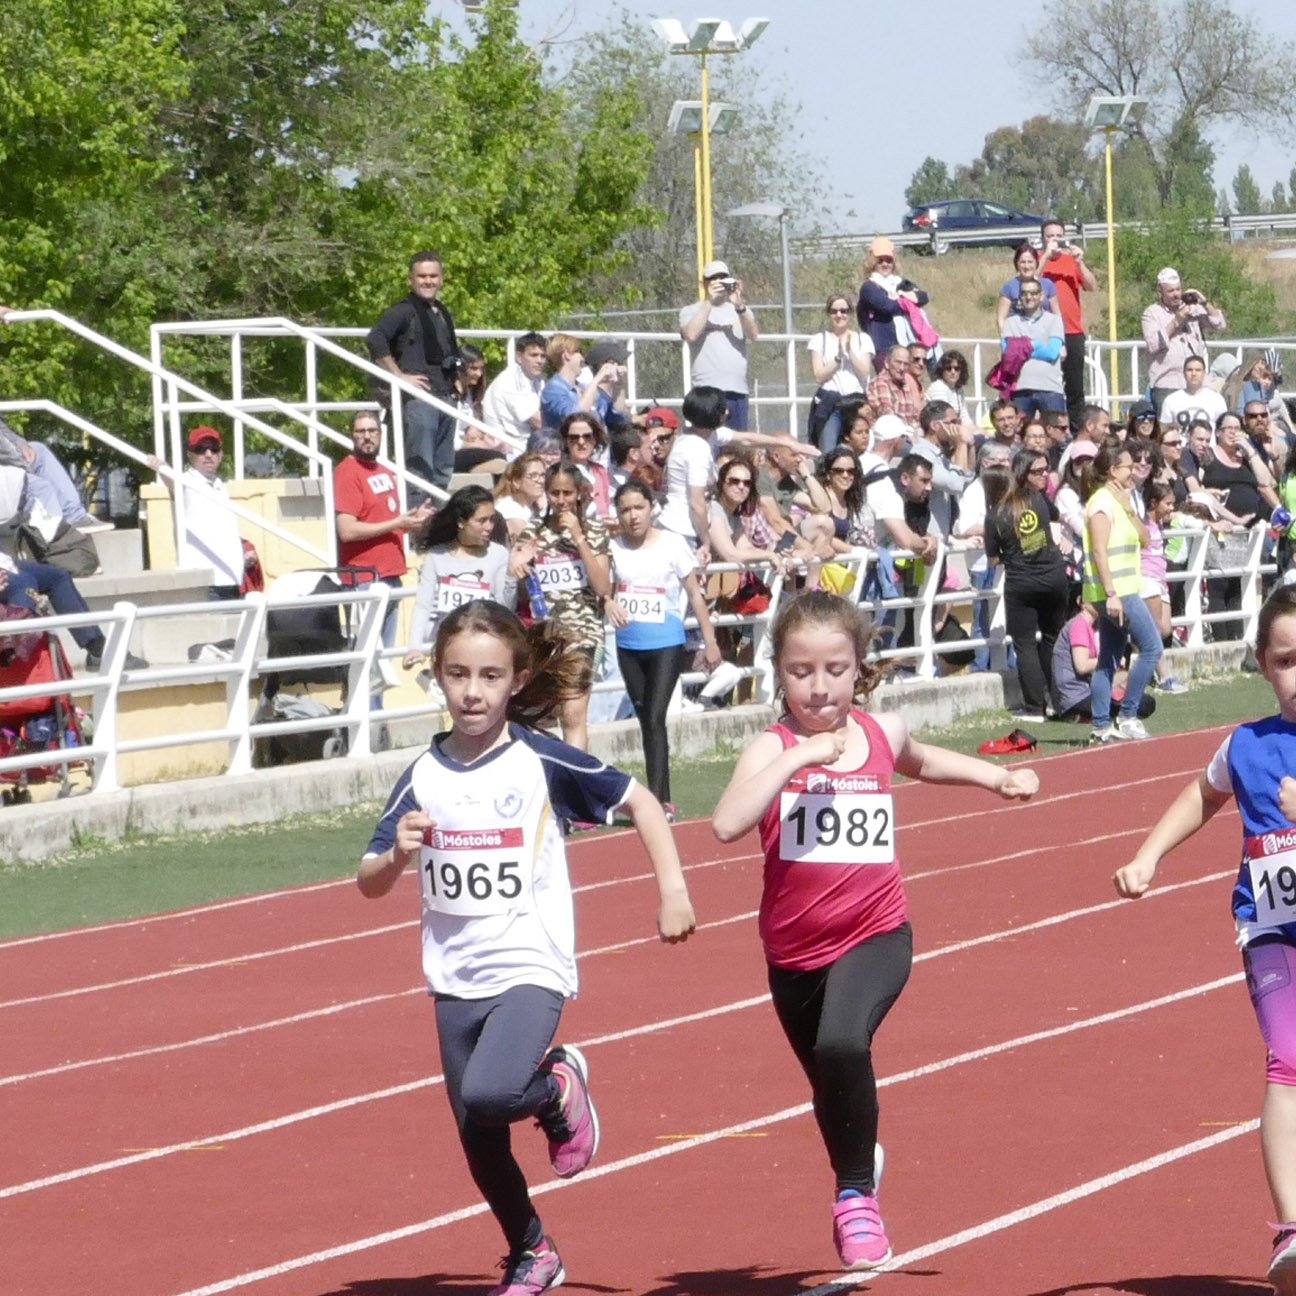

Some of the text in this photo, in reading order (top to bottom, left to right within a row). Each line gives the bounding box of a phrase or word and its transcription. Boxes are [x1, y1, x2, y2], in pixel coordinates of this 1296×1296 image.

[539, 565, 584, 585] 2033
[441, 590, 485, 607] 197
[619, 597, 662, 616] 2034
[788, 806, 889, 847] 1982
[444, 834, 502, 847] Móstoles
[424, 859, 522, 900] 1965
